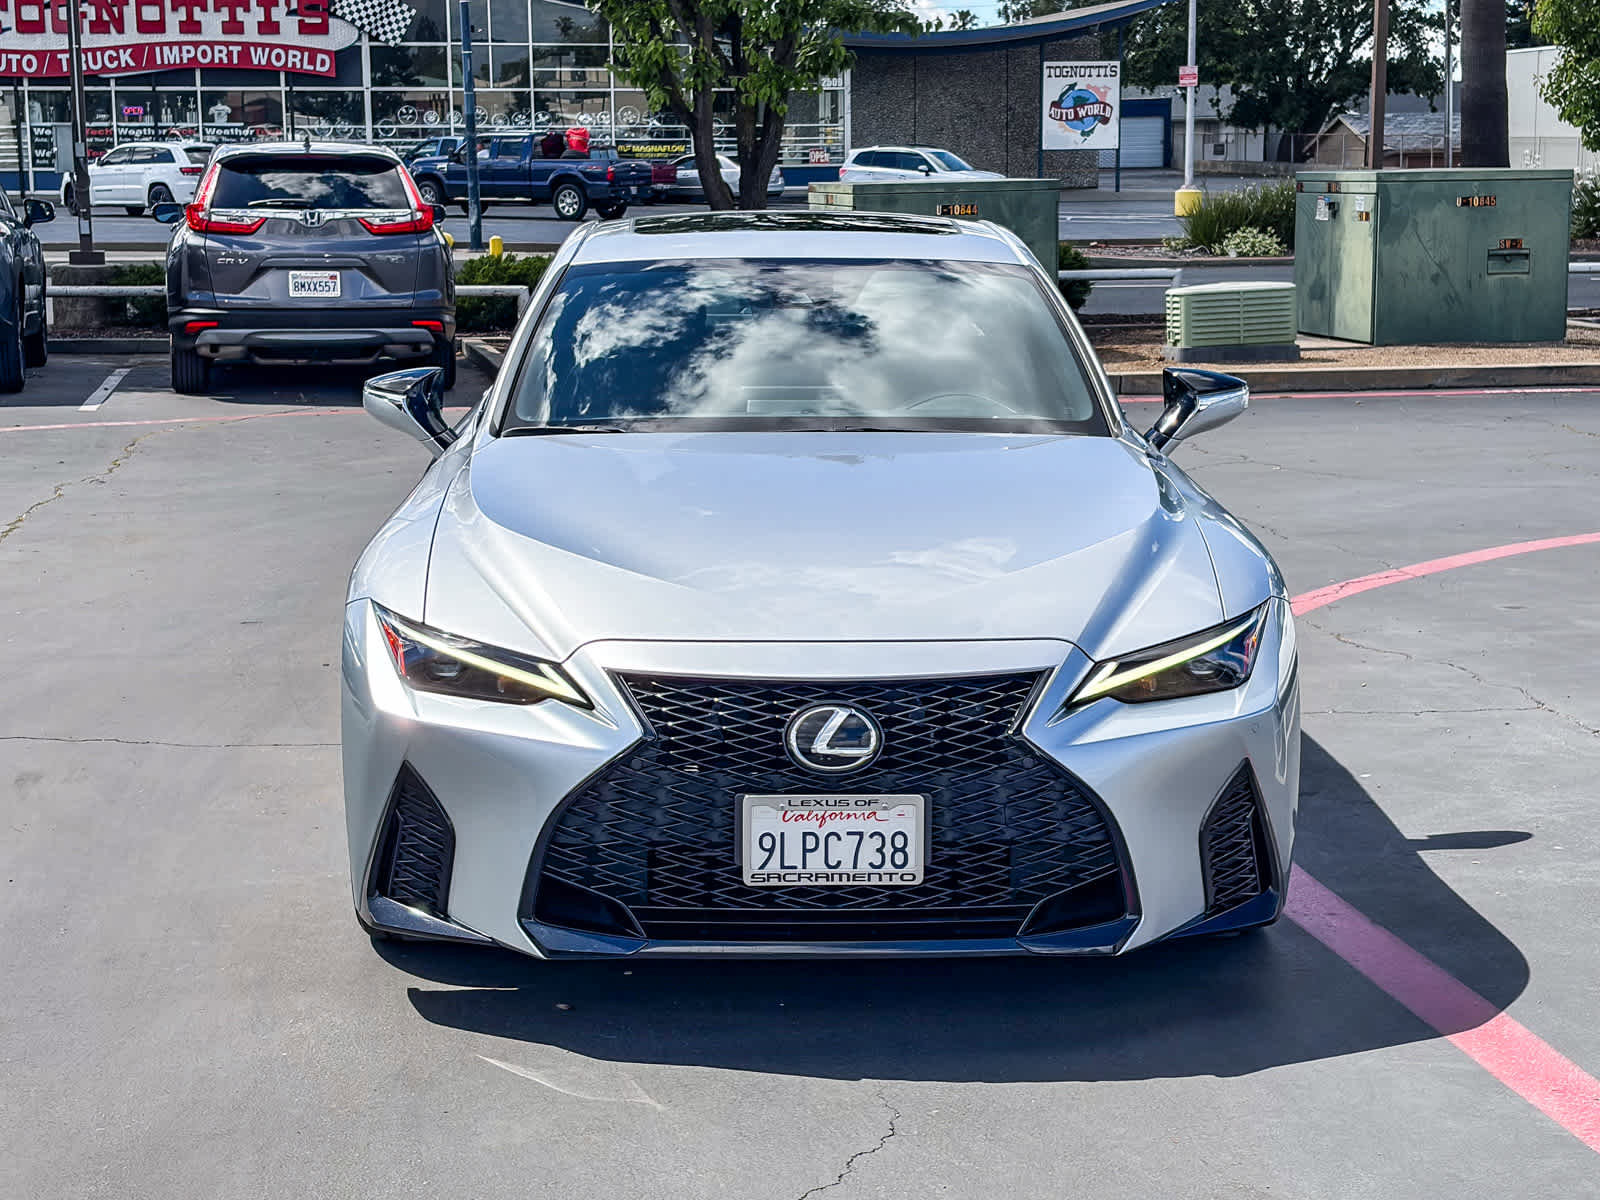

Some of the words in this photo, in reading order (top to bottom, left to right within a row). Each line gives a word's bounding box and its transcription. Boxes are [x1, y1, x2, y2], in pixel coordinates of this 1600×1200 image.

[0, 0, 329, 34] OGNOTTI'S
[154, 45, 242, 65] IMPORT
[249, 46, 330, 72] WORLD
[1046, 64, 1118, 78] TOGNOTTI'S
[123, 107, 143, 115] OPEN
[1050, 107, 1074, 120] AUTO
[1077, 104, 1112, 118] WORLD
[810, 151, 829, 162] OPEN
[294, 280, 336, 293] 8MXX557
[788, 799, 850, 807] LEXUS
[854, 799, 880, 807] OF
[782, 810, 888, 828] California
[758, 830, 909, 870] 9LPC738
[750, 872, 917, 883] SACRAMENTO
